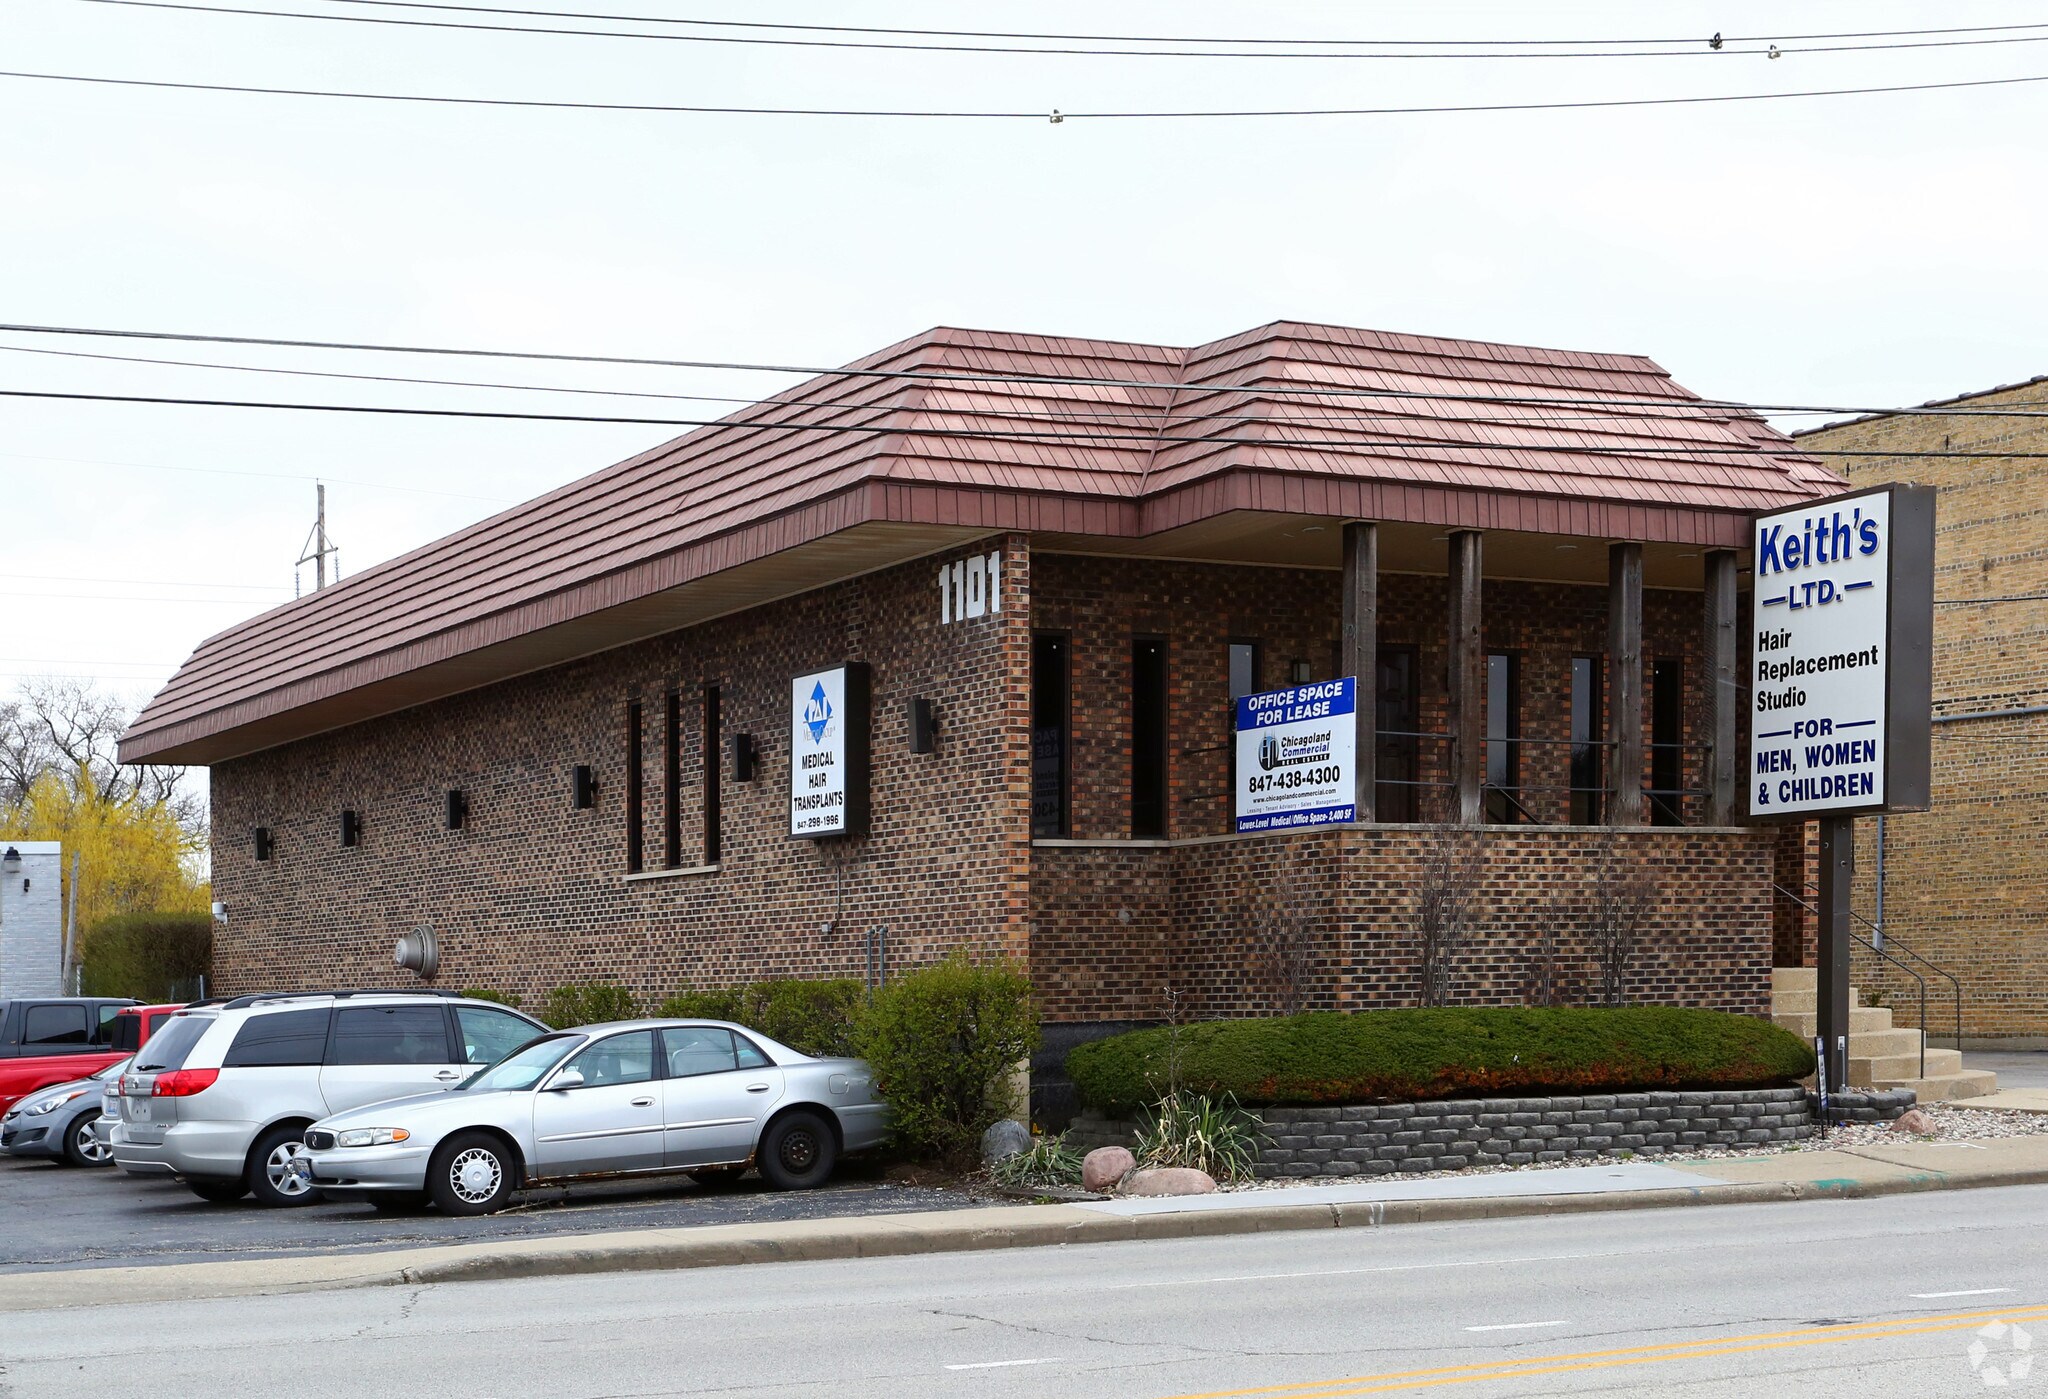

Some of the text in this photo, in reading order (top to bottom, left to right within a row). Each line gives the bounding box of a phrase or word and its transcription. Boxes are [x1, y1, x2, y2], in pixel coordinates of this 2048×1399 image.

[1759, 507, 1879, 576] Keith's
[939, 550, 1000, 625] 1101
[1789, 579, 1842, 610] LTD.
[1758, 628, 1792, 652] Hair
[1758, 645, 1878, 681] Replacement
[1248, 681, 1343, 711] OFFICE SPACE
[1757, 686, 1806, 712] Studio
[1256, 701, 1330, 726] FOR LEASE
[1281, 730, 1331, 748] Chicagoland
[1793, 718, 1833, 739] FOR
[802, 751, 834, 770] MEDICAL
[1282, 742, 1329, 758] Commercial
[1757, 739, 1876, 775] MEN, WOMEN
[808, 772, 827, 789] HAIR
[1249, 765, 1341, 793] 847-438-4300
[1758, 771, 1874, 805] & CHILDREN
[794, 791, 843, 811] TRANSPLANTS
[1253, 788, 1336, 804] www.chicagolandcommercial.com
[797, 814, 839, 829] 847-298-1996
[1328, 809, 1344, 822] 2,400
[1344, 808, 1352, 819] SF
